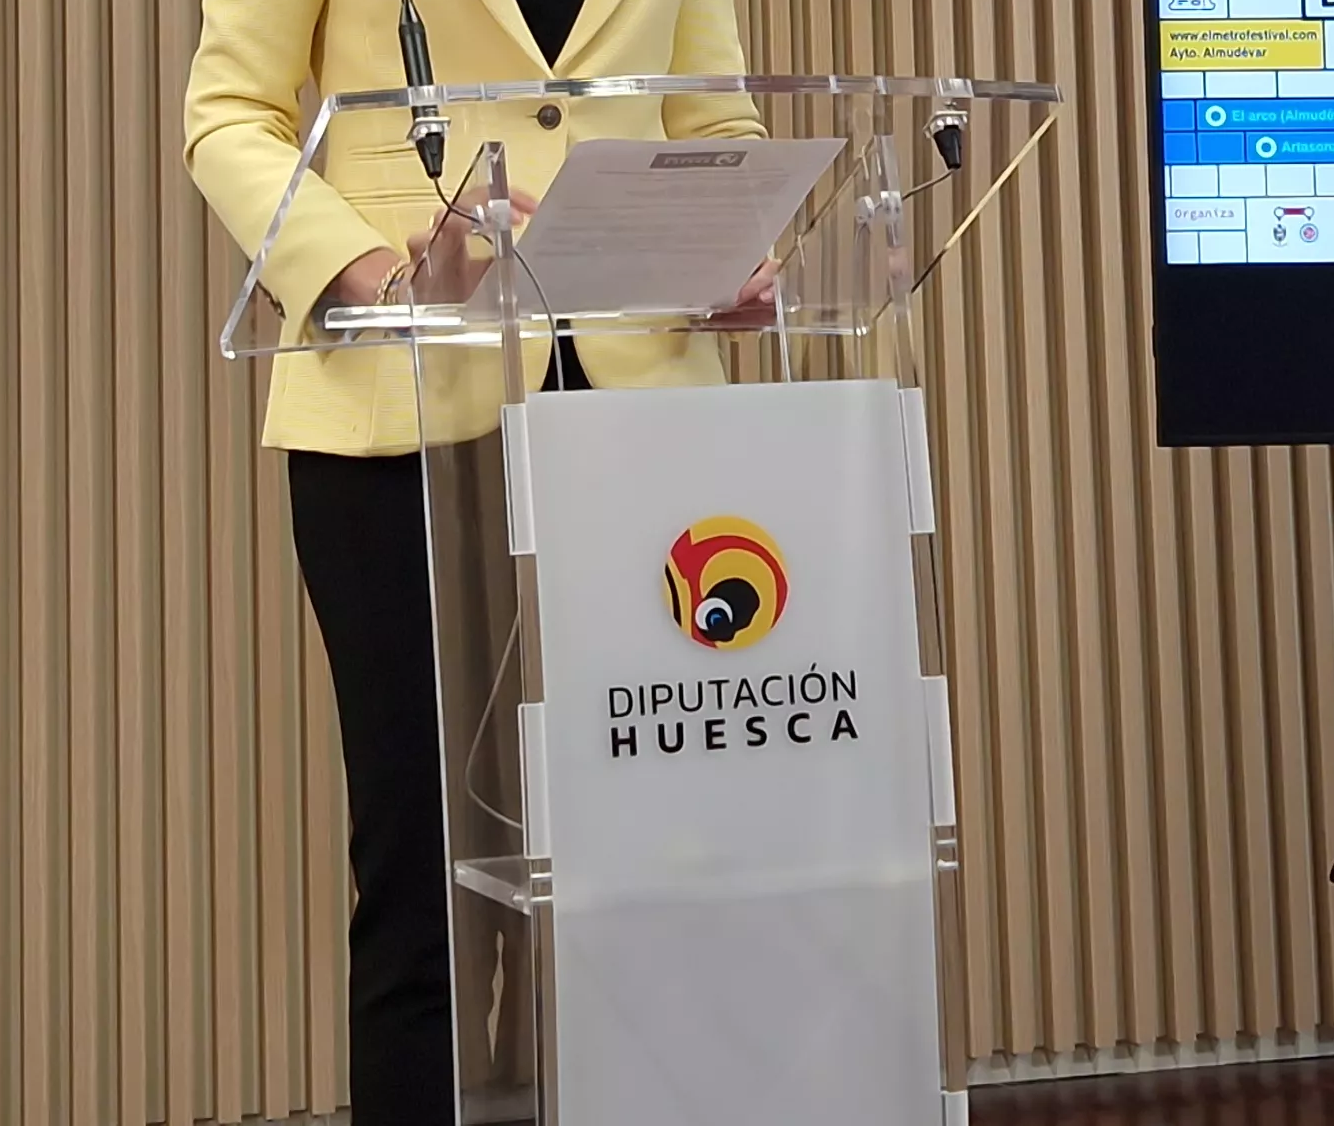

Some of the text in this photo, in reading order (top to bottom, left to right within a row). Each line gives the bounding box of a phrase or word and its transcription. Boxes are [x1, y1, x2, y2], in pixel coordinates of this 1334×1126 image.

[1169, 29, 1318, 42] www.elmetrofestival.com
[1169, 47, 1267, 61] Ayto. Almudévar
[1232, 109, 1244, 121] El
[1248, 112, 1277, 121] arco
[1174, 208, 1235, 221] Organiza
[608, 662, 857, 719] DIPUTACIÓN
[610, 709, 859, 758] HUESCA
